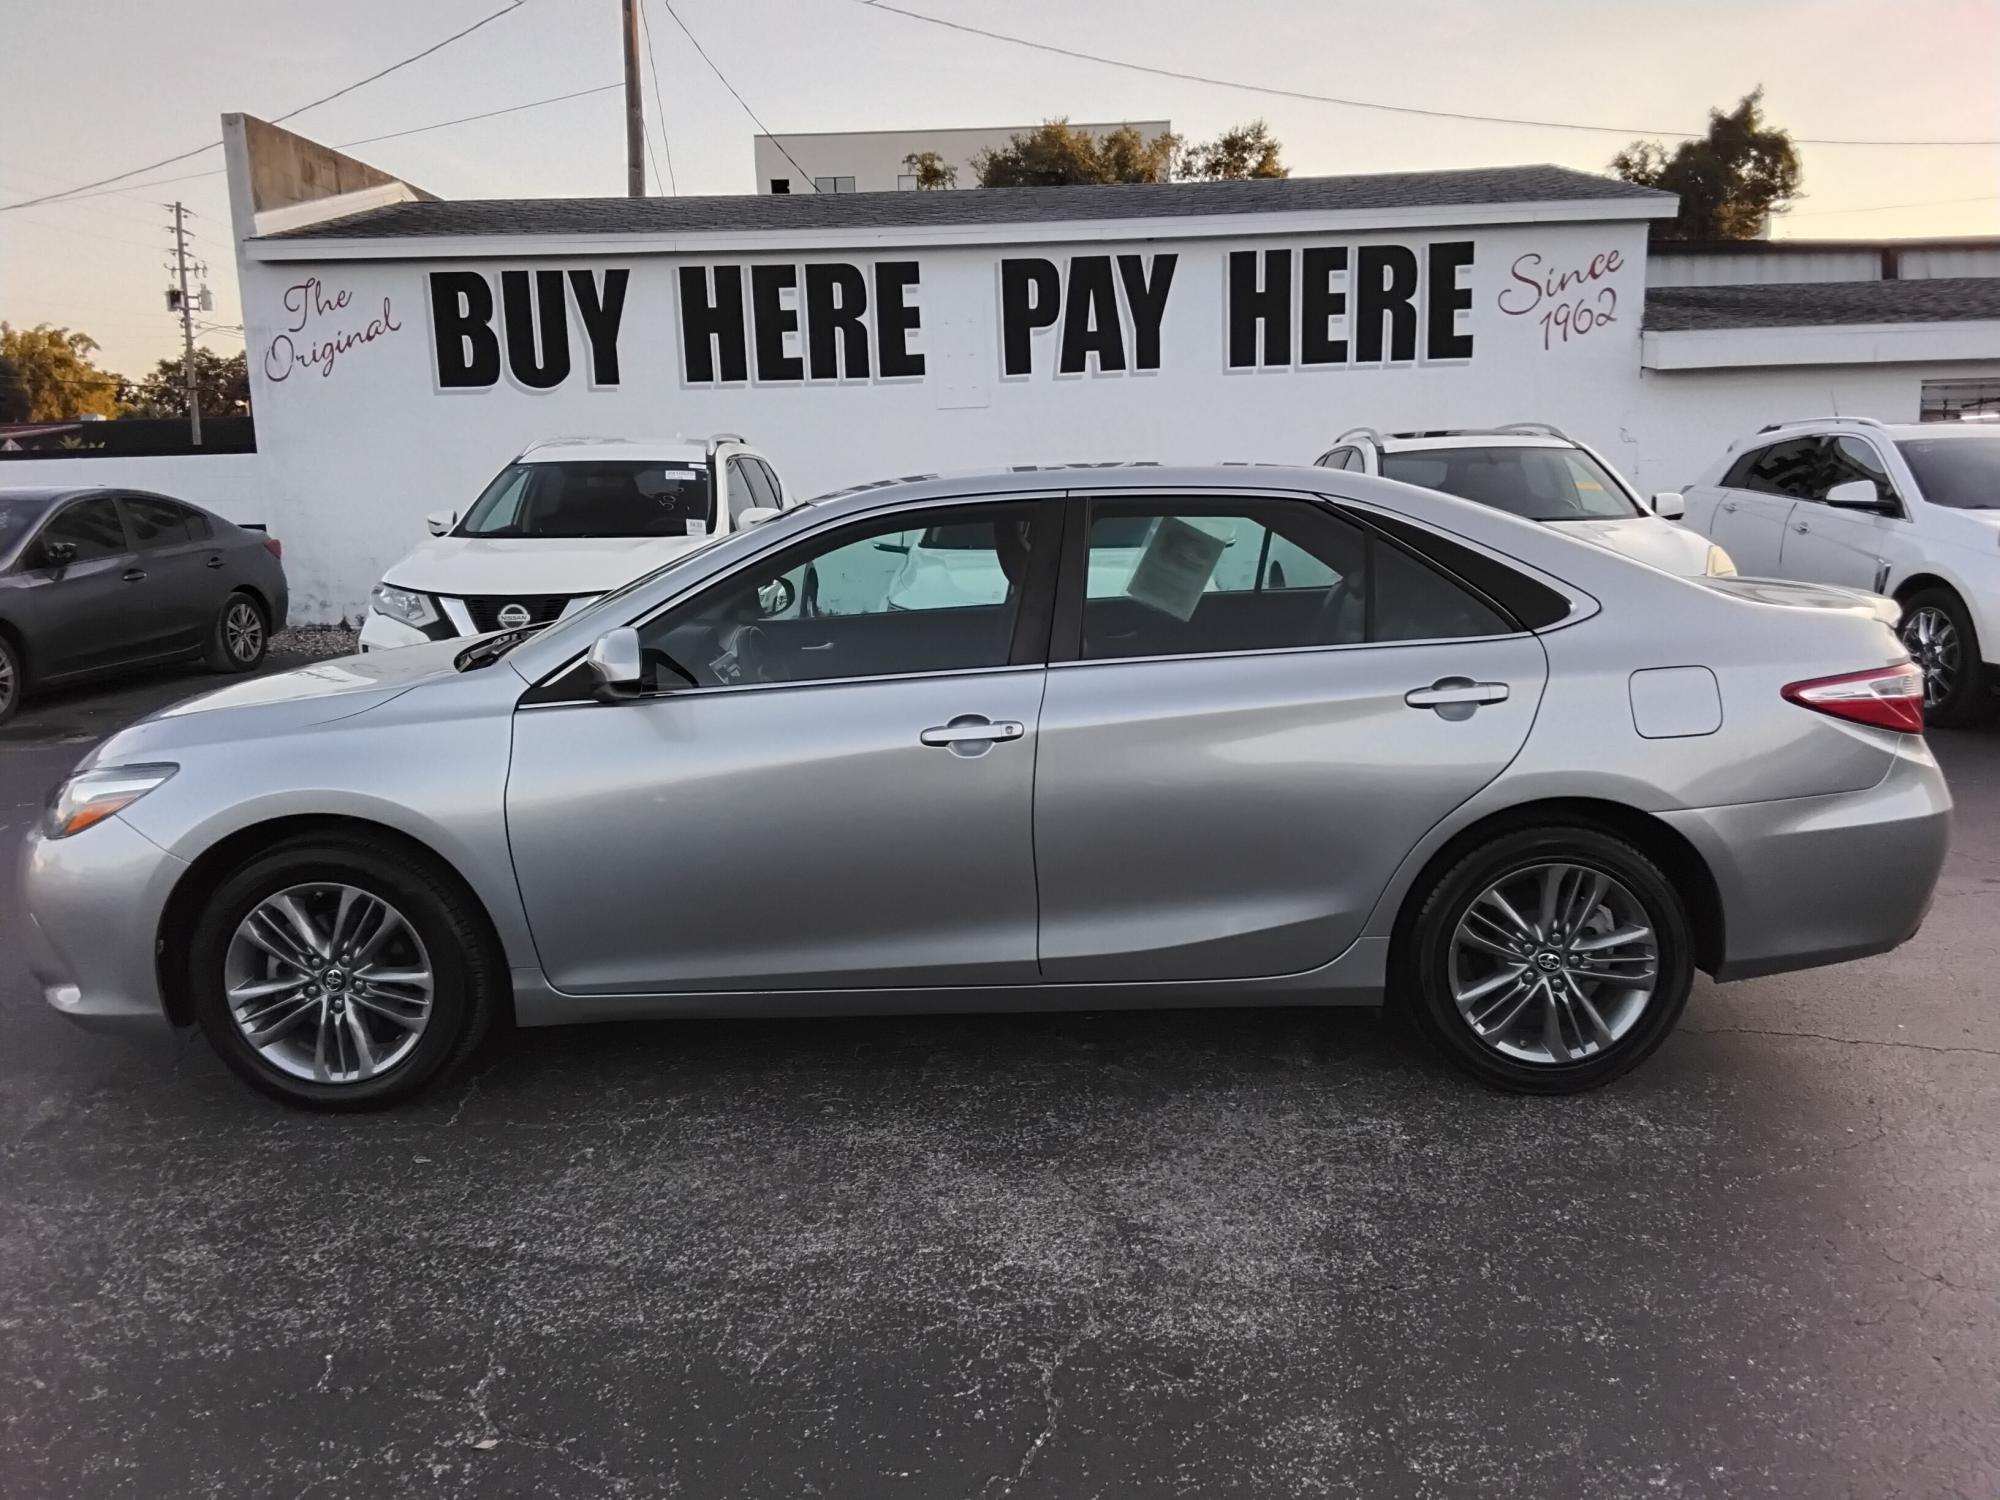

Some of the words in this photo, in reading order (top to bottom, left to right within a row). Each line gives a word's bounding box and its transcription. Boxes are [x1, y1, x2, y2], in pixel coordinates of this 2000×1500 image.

[284, 277, 352, 332] The
[428, 269, 630, 389] BUY
[677, 261, 926, 383] HERE
[1001, 254, 1179, 376] PAY
[1228, 241, 1475, 368] HERE
[1498, 249, 1625, 315] Since
[265, 297, 402, 382] Original
[1540, 287, 1617, 351] 1962
